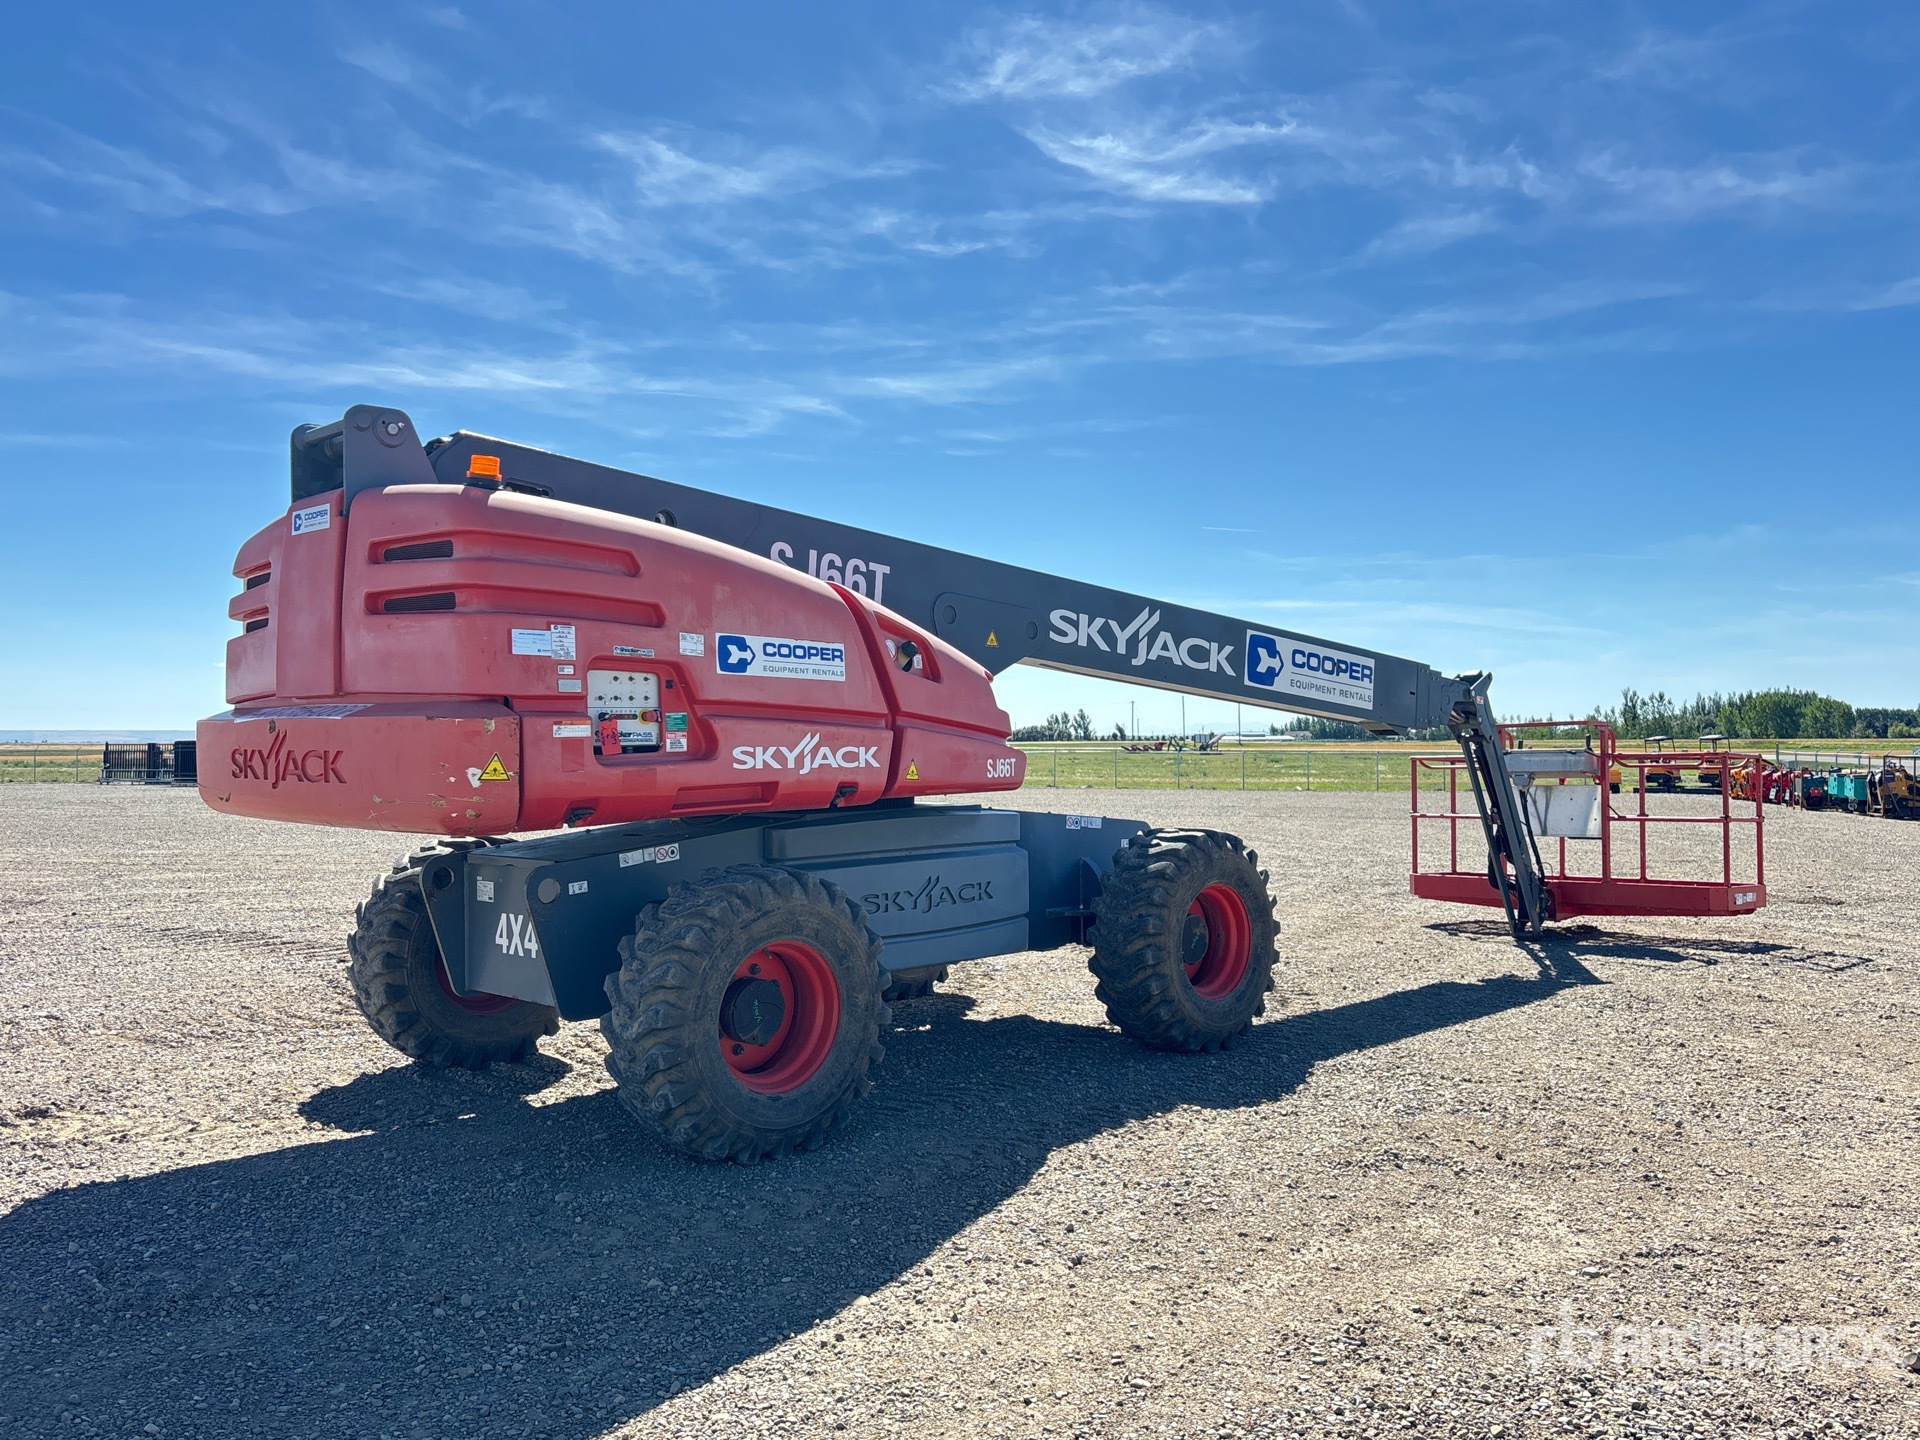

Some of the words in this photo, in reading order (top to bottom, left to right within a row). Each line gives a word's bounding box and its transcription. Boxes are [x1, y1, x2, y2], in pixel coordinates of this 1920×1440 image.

[304, 508, 328, 521] COOPER
[762, 641, 844, 663] COOPER
[1049, 606, 1237, 677] SKYJACK
[762, 665, 810, 676] EQUIPMENT
[811, 668, 845, 677] RENTALS
[1290, 648, 1374, 684] COOPER
[1290, 679, 1337, 697] EQUIPMENT
[1339, 688, 1373, 704] RENTALS
[231, 729, 347, 789] SKYJACK
[732, 732, 881, 774] SKYJACK
[986, 758, 1016, 779] SJ66T
[860, 875, 994, 914] SKYJACK
[495, 912, 539, 958] 4X4
